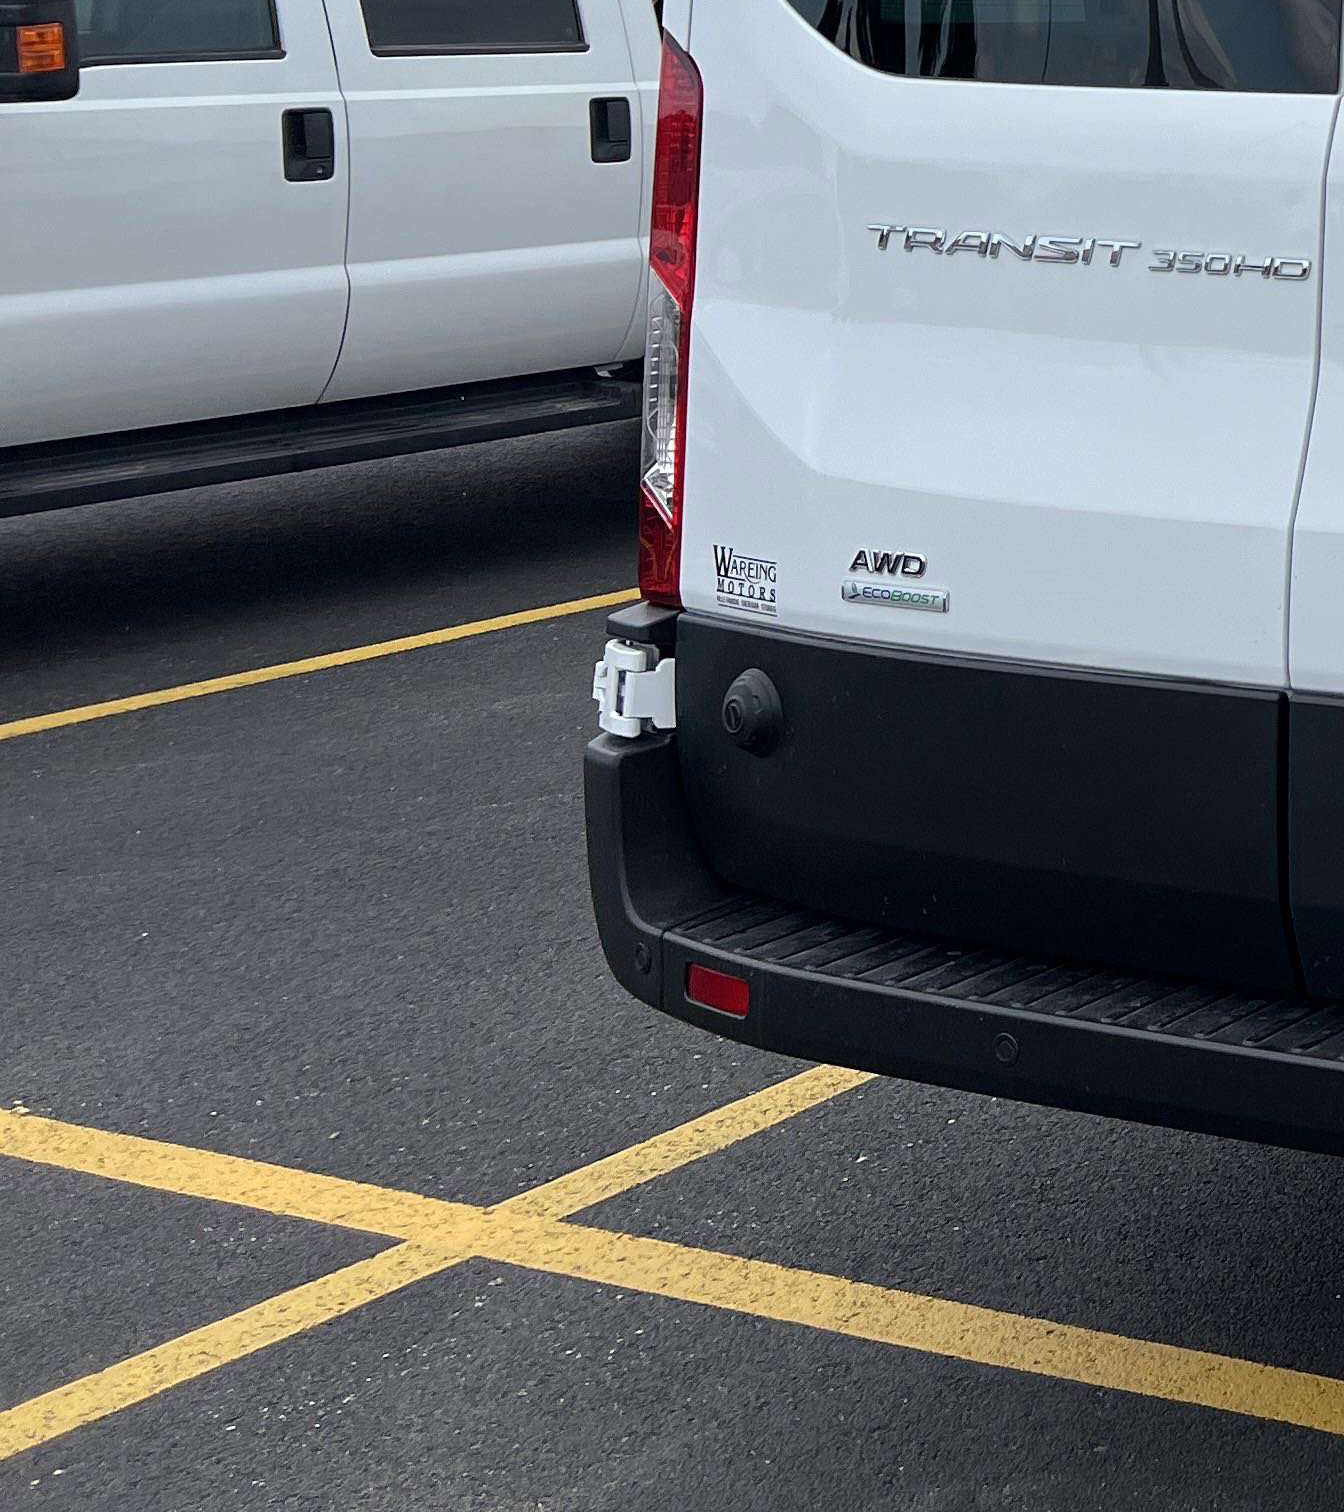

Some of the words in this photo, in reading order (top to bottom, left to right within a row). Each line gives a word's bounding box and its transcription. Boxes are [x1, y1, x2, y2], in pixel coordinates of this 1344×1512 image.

[867, 223, 1141, 267] TRANSIT
[1148, 249, 1312, 280] 350HD
[850, 548, 928, 579] AWD
[716, 577, 776, 602] MOTORS
